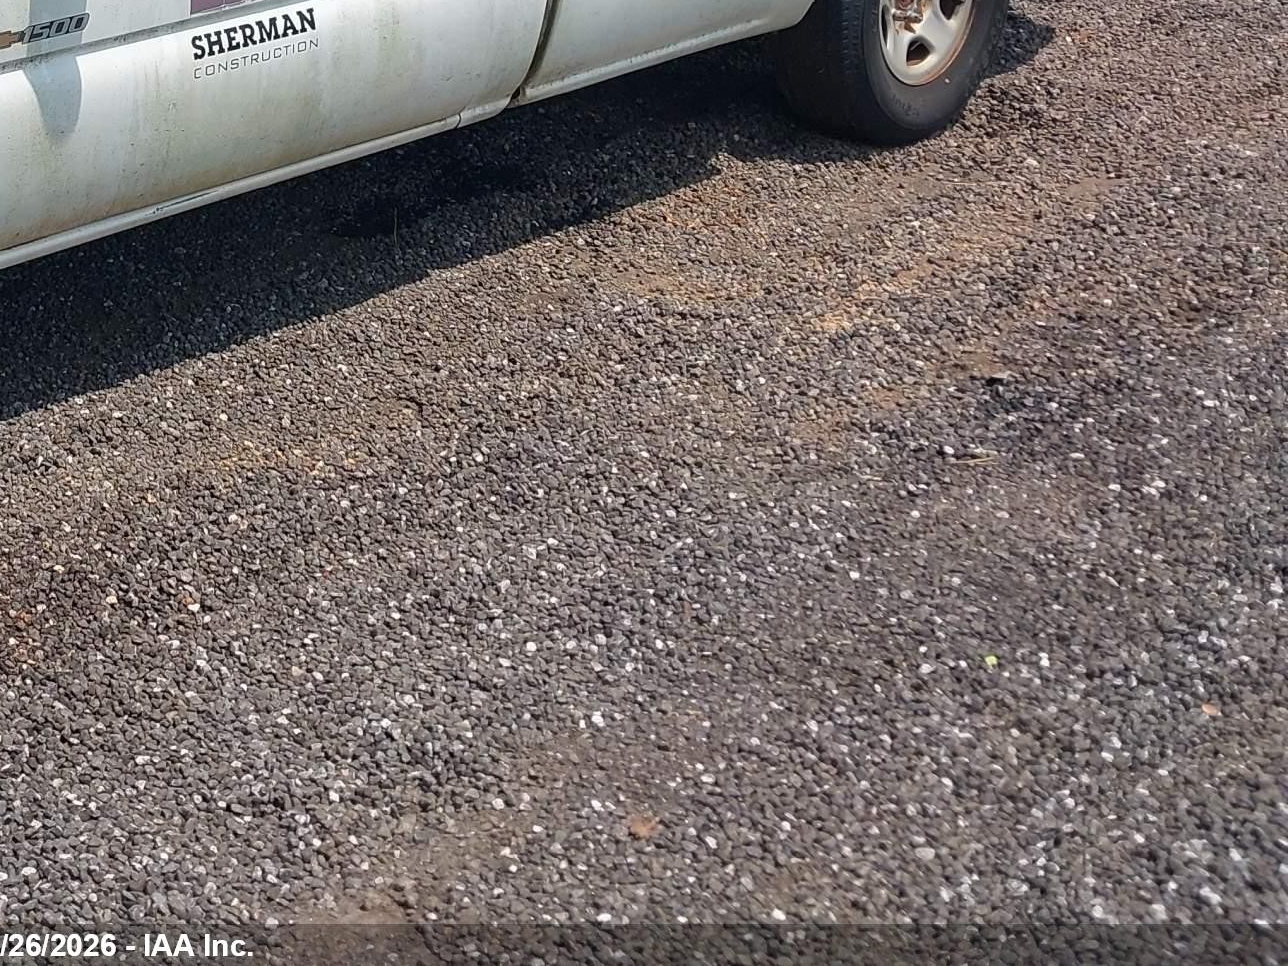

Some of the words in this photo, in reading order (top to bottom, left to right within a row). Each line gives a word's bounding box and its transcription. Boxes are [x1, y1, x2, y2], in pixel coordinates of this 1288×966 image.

[22, 13, 90, 45] 1500
[191, 7, 317, 61] SHERMAN
[193, 38, 319, 80] CONSTRUCTION
